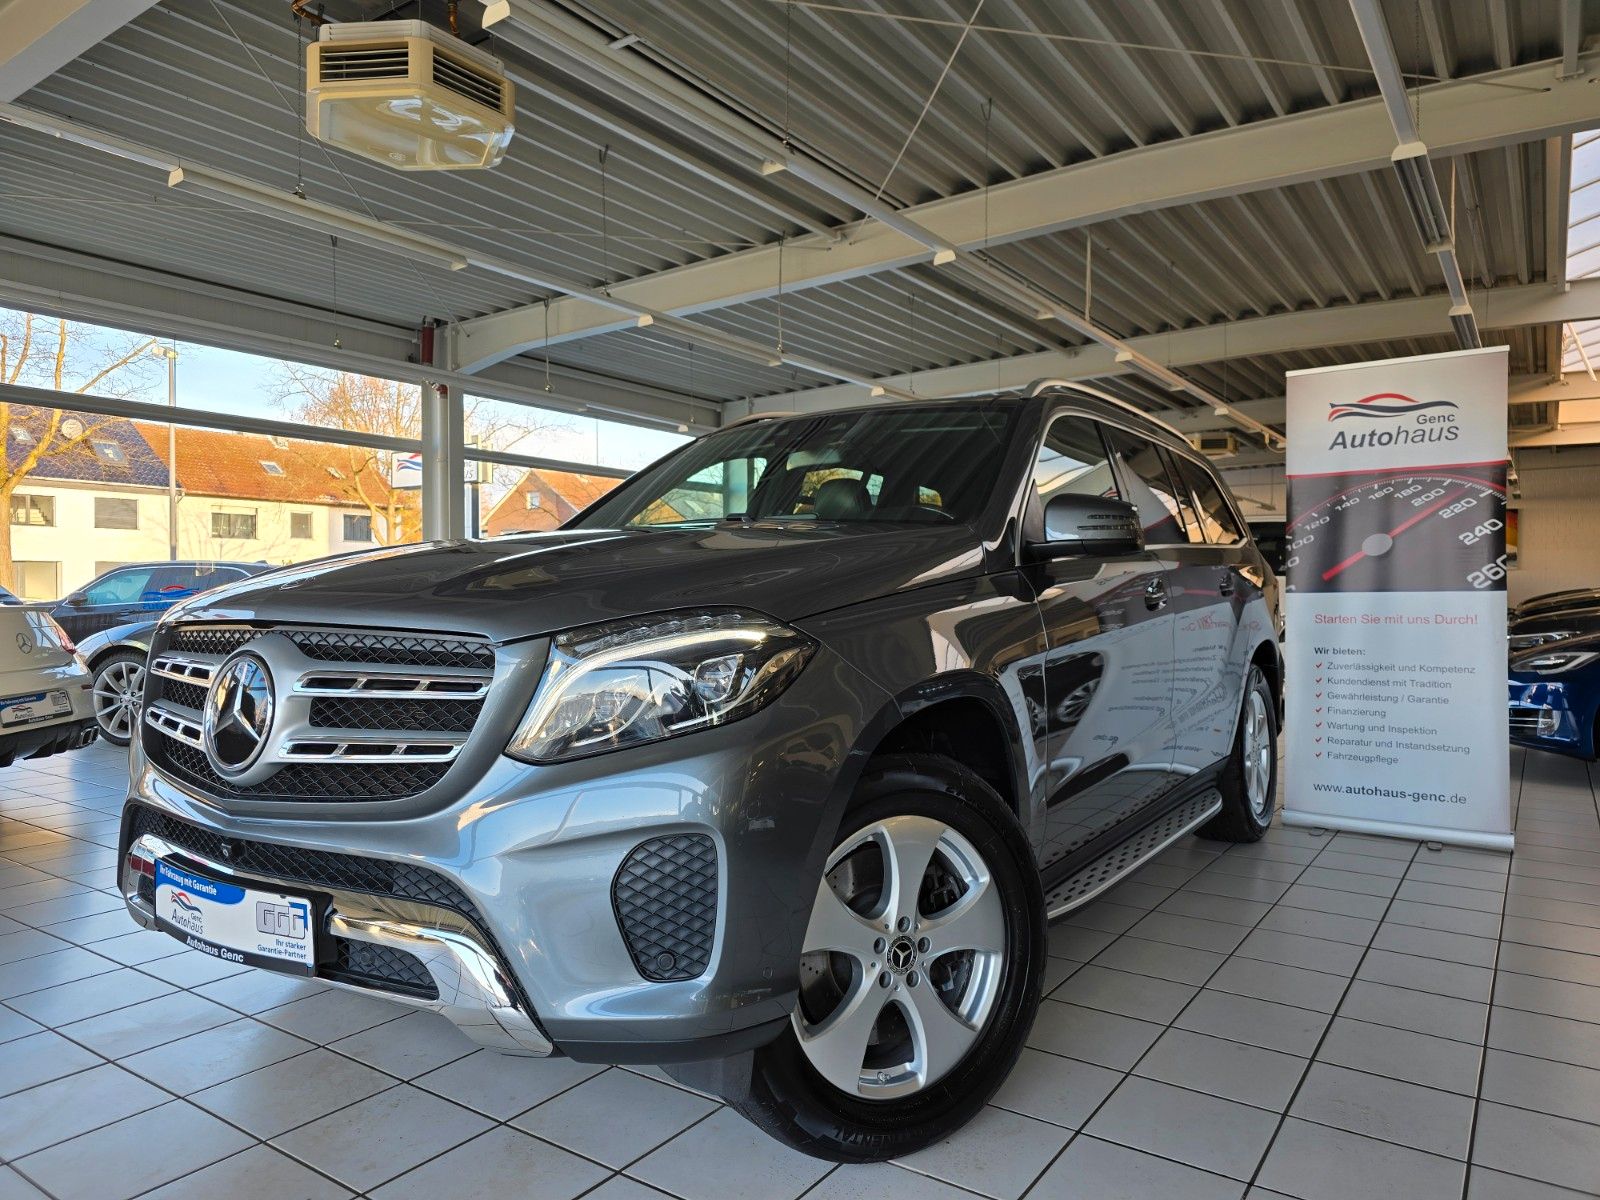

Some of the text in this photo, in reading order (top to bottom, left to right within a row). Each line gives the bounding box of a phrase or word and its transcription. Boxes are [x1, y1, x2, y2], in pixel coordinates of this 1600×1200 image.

[1416, 413, 1455, 425] Genc
[1328, 425, 1460, 451] Autohaus
[1368, 486, 1394, 501] 160
[1394, 484, 1423, 499] 180
[1411, 487, 1446, 507] 200
[1334, 497, 1361, 511] 140
[1438, 497, 1478, 519] 220
[1304, 515, 1331, 532] 120
[1458, 518, 1504, 546] 240
[1285, 534, 1315, 552] 100
[1314, 613, 1478, 625] Starten Sie mit uns Durch!
[1314, 646, 1367, 656] Wir bieten:
[1327, 661, 1476, 675] Zuverlässigkeit und Kompetenz
[1327, 677, 1452, 689] Kundendienst mit Tradition
[1327, 691, 1399, 704] Gewährleistung
[1407, 694, 1450, 705] Garantie
[1327, 706, 1387, 719] Finanzierung
[1327, 721, 1438, 736] Wartung und Inspektion
[1327, 736, 1471, 755] Reparatur und Instandsetzung
[1327, 751, 1399, 765] Fahrzeugpflege
[1312, 782, 1467, 805] www.autohaus-genc.de
[166, 867, 184, 887] Fahrzeug
[184, 877, 193, 888] mit
[192, 879, 217, 897] Garantie
[171, 908, 204, 935] Autohaus
[190, 912, 203, 924] Genc
[186, 935, 244, 963] Autohaus Genc
[257, 944, 307, 960] Garantie-Partner
[275, 938, 307, 951] Ihr starker
